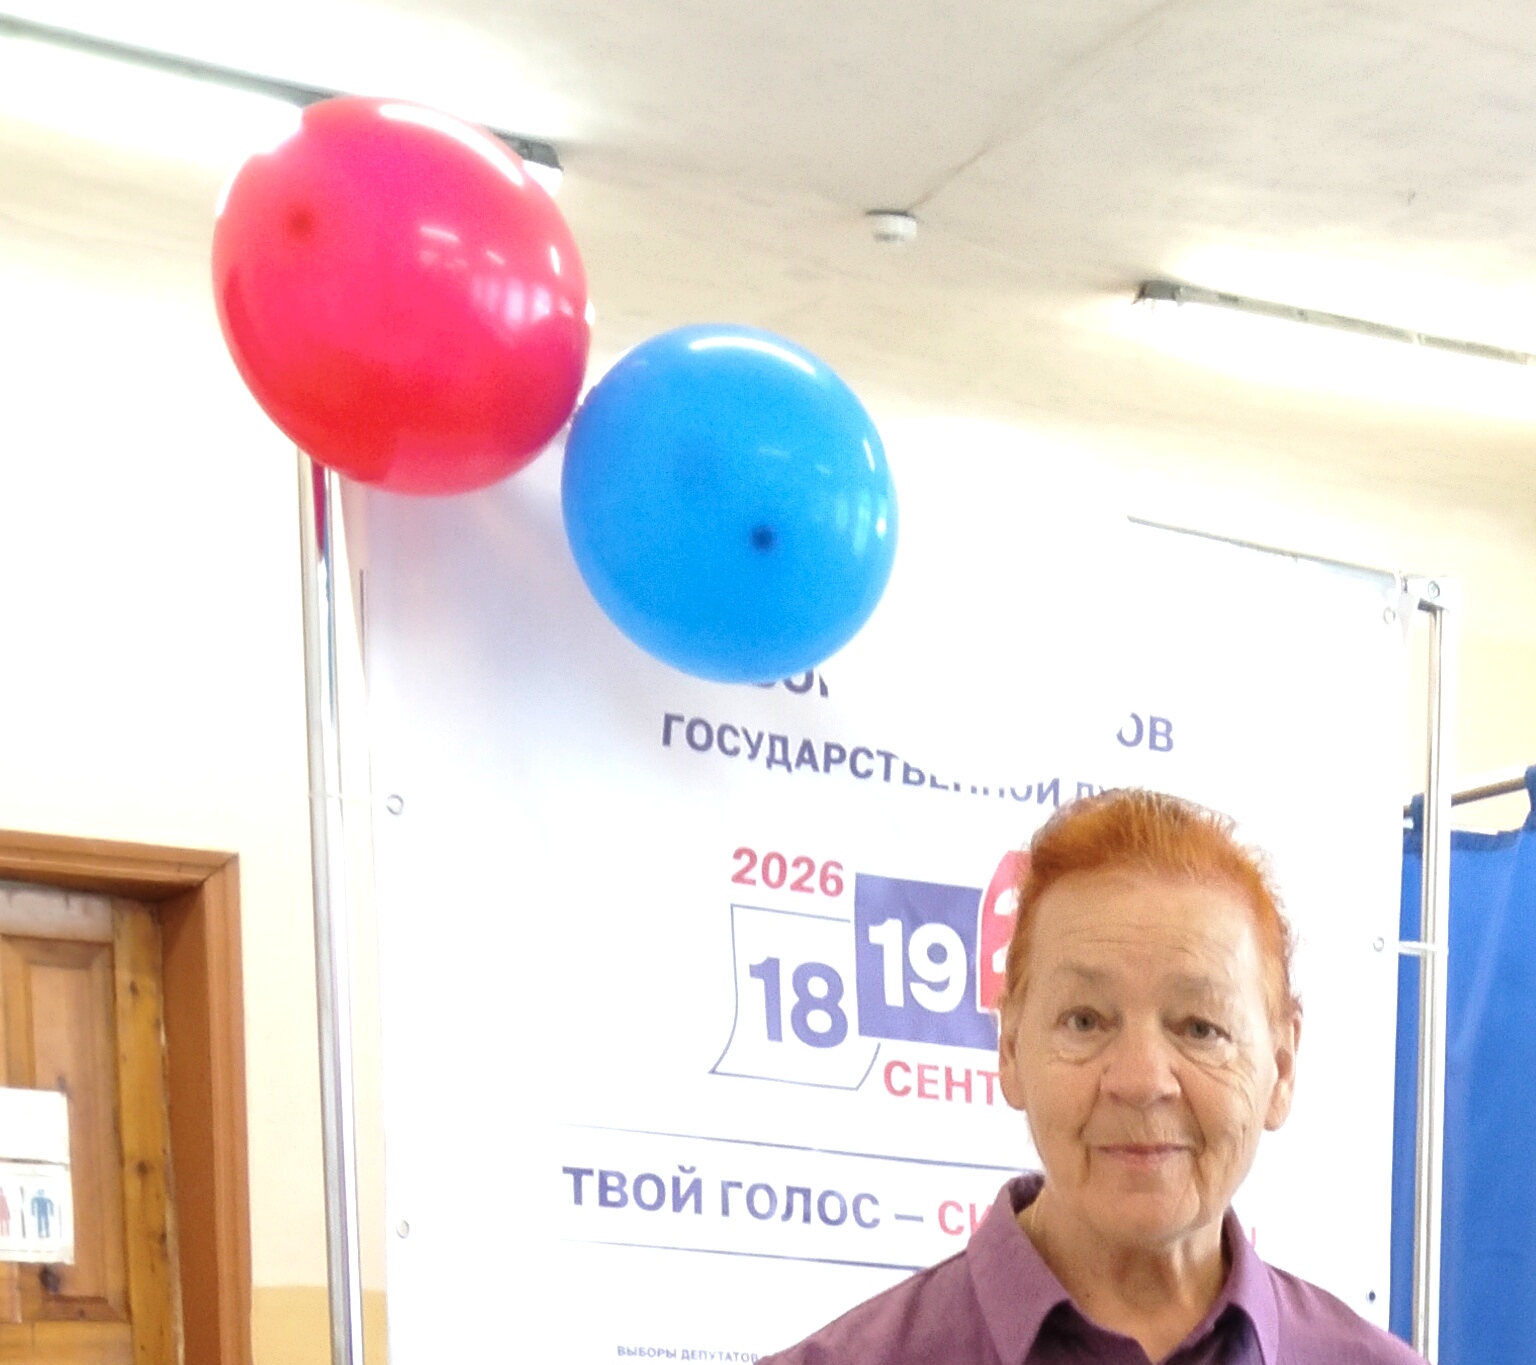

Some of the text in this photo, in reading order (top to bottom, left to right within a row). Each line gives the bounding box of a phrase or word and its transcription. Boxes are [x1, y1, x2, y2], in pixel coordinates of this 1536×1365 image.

[731, 846, 844, 898] 2026
[749, 956, 849, 1049] 18
[868, 917, 967, 1014] 19
[883, 1060, 1000, 1106] СЕНТ
[562, 1164, 703, 1216] ТВОЙ
[720, 1180, 881, 1230] ГОЛОС
[937, 1199, 994, 1237] СИ
[616, 1345, 678, 1360] ВЫБОРЫ
